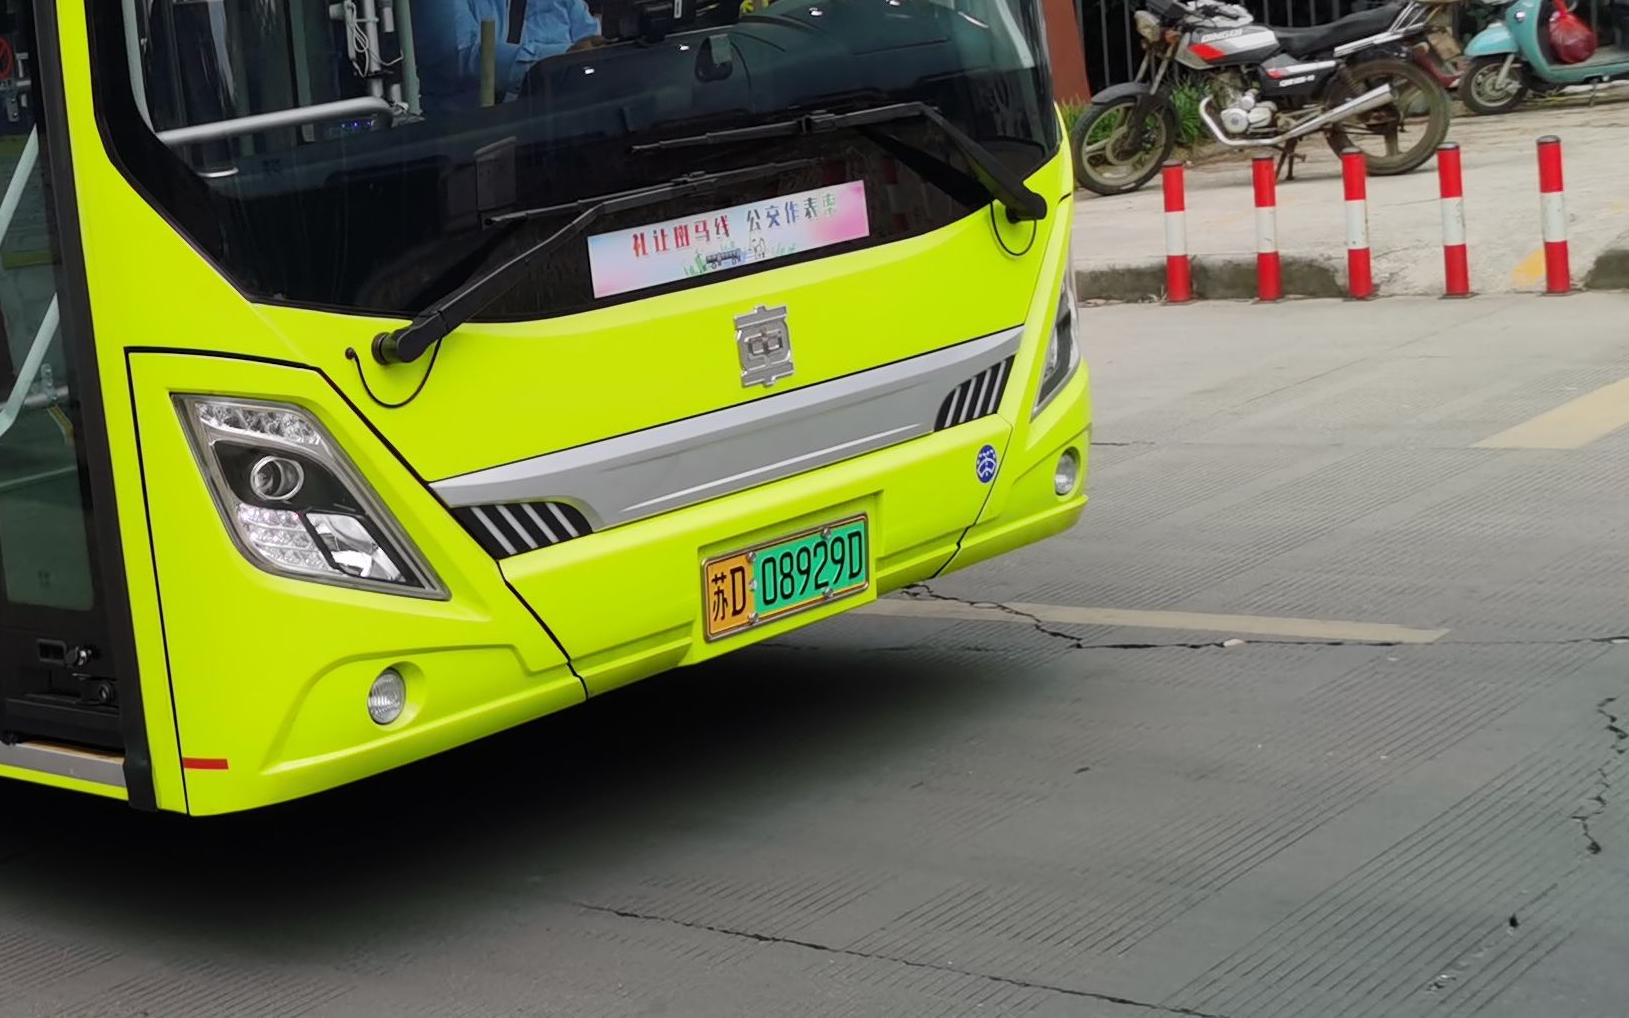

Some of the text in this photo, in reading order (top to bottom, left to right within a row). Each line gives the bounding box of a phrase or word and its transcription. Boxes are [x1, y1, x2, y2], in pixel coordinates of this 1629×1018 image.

[632, 192, 836, 257] 礼让斑马线 公交作表率
[711, 530, 863, 622] 苏D 08929D
